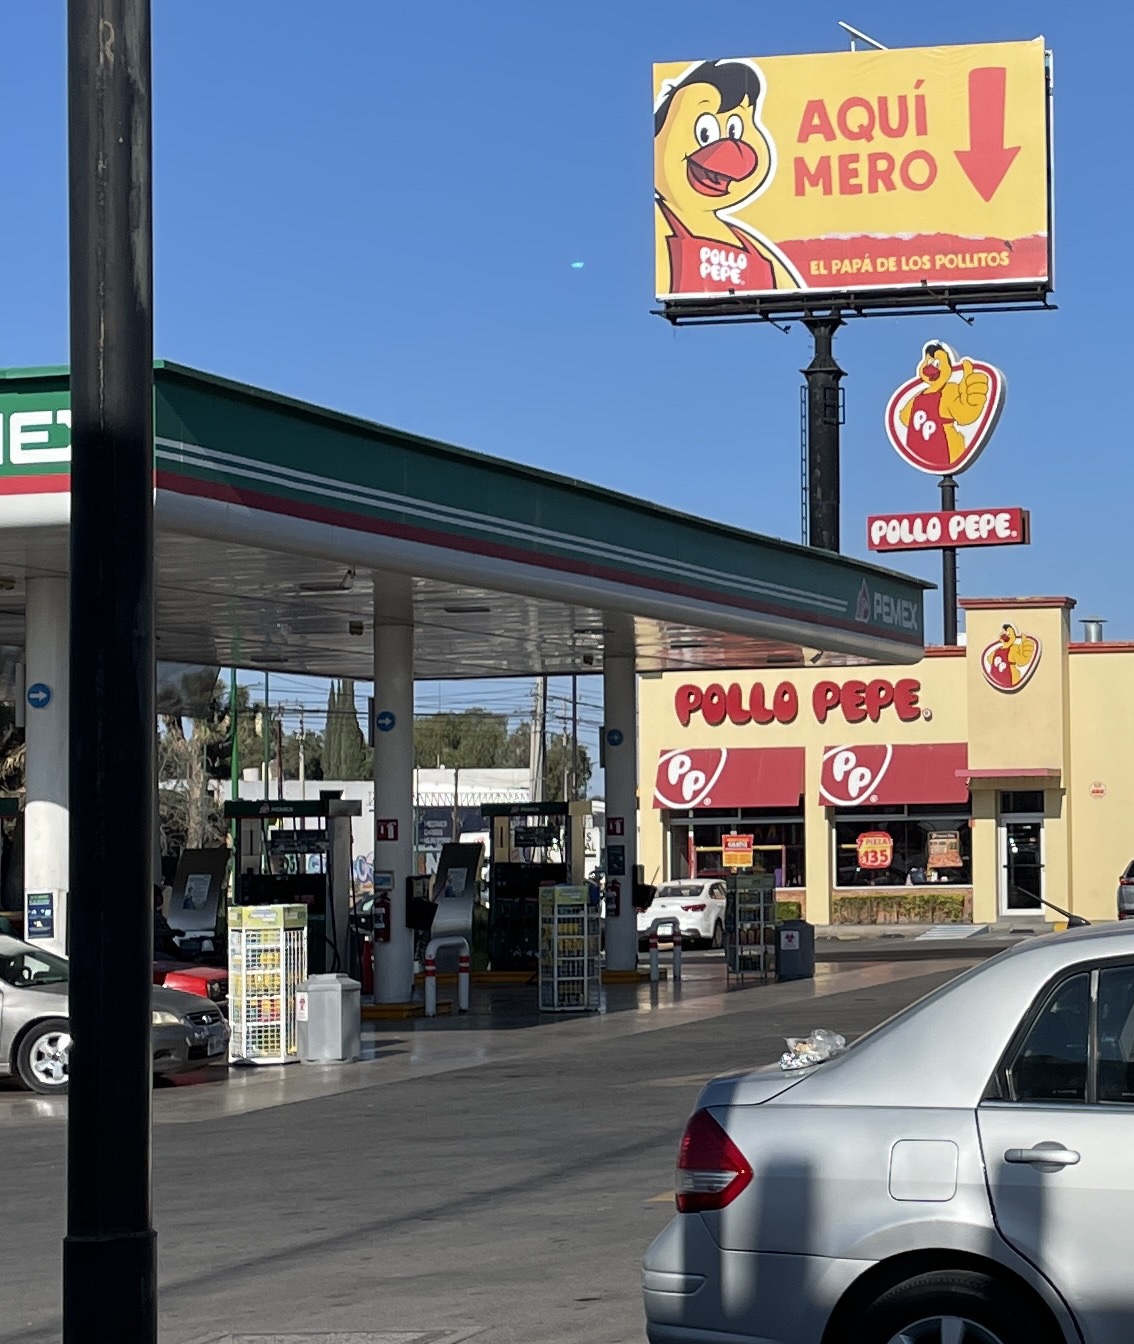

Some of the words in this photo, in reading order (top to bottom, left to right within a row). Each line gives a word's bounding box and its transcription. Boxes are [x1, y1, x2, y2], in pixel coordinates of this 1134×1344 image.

[797, 79, 928, 144] AQUÍ
[793, 149, 938, 197] MERO
[699, 246, 748, 271] POLLO
[699, 262, 742, 285] PEPE
[809, 259, 829, 275] EL
[831, 253, 873, 275] PAPÁ
[875, 256, 898, 273] DE
[901, 255, 931, 271] LOS
[934, 251, 1010, 270] POLLITOS
[870, 516, 942, 546] POLLO
[948, 512, 1012, 541] PEPE
[873, 591, 918, 631] PEMEX
[674, 681, 799, 728] POLLO
[812, 678, 922, 725] PEPE
